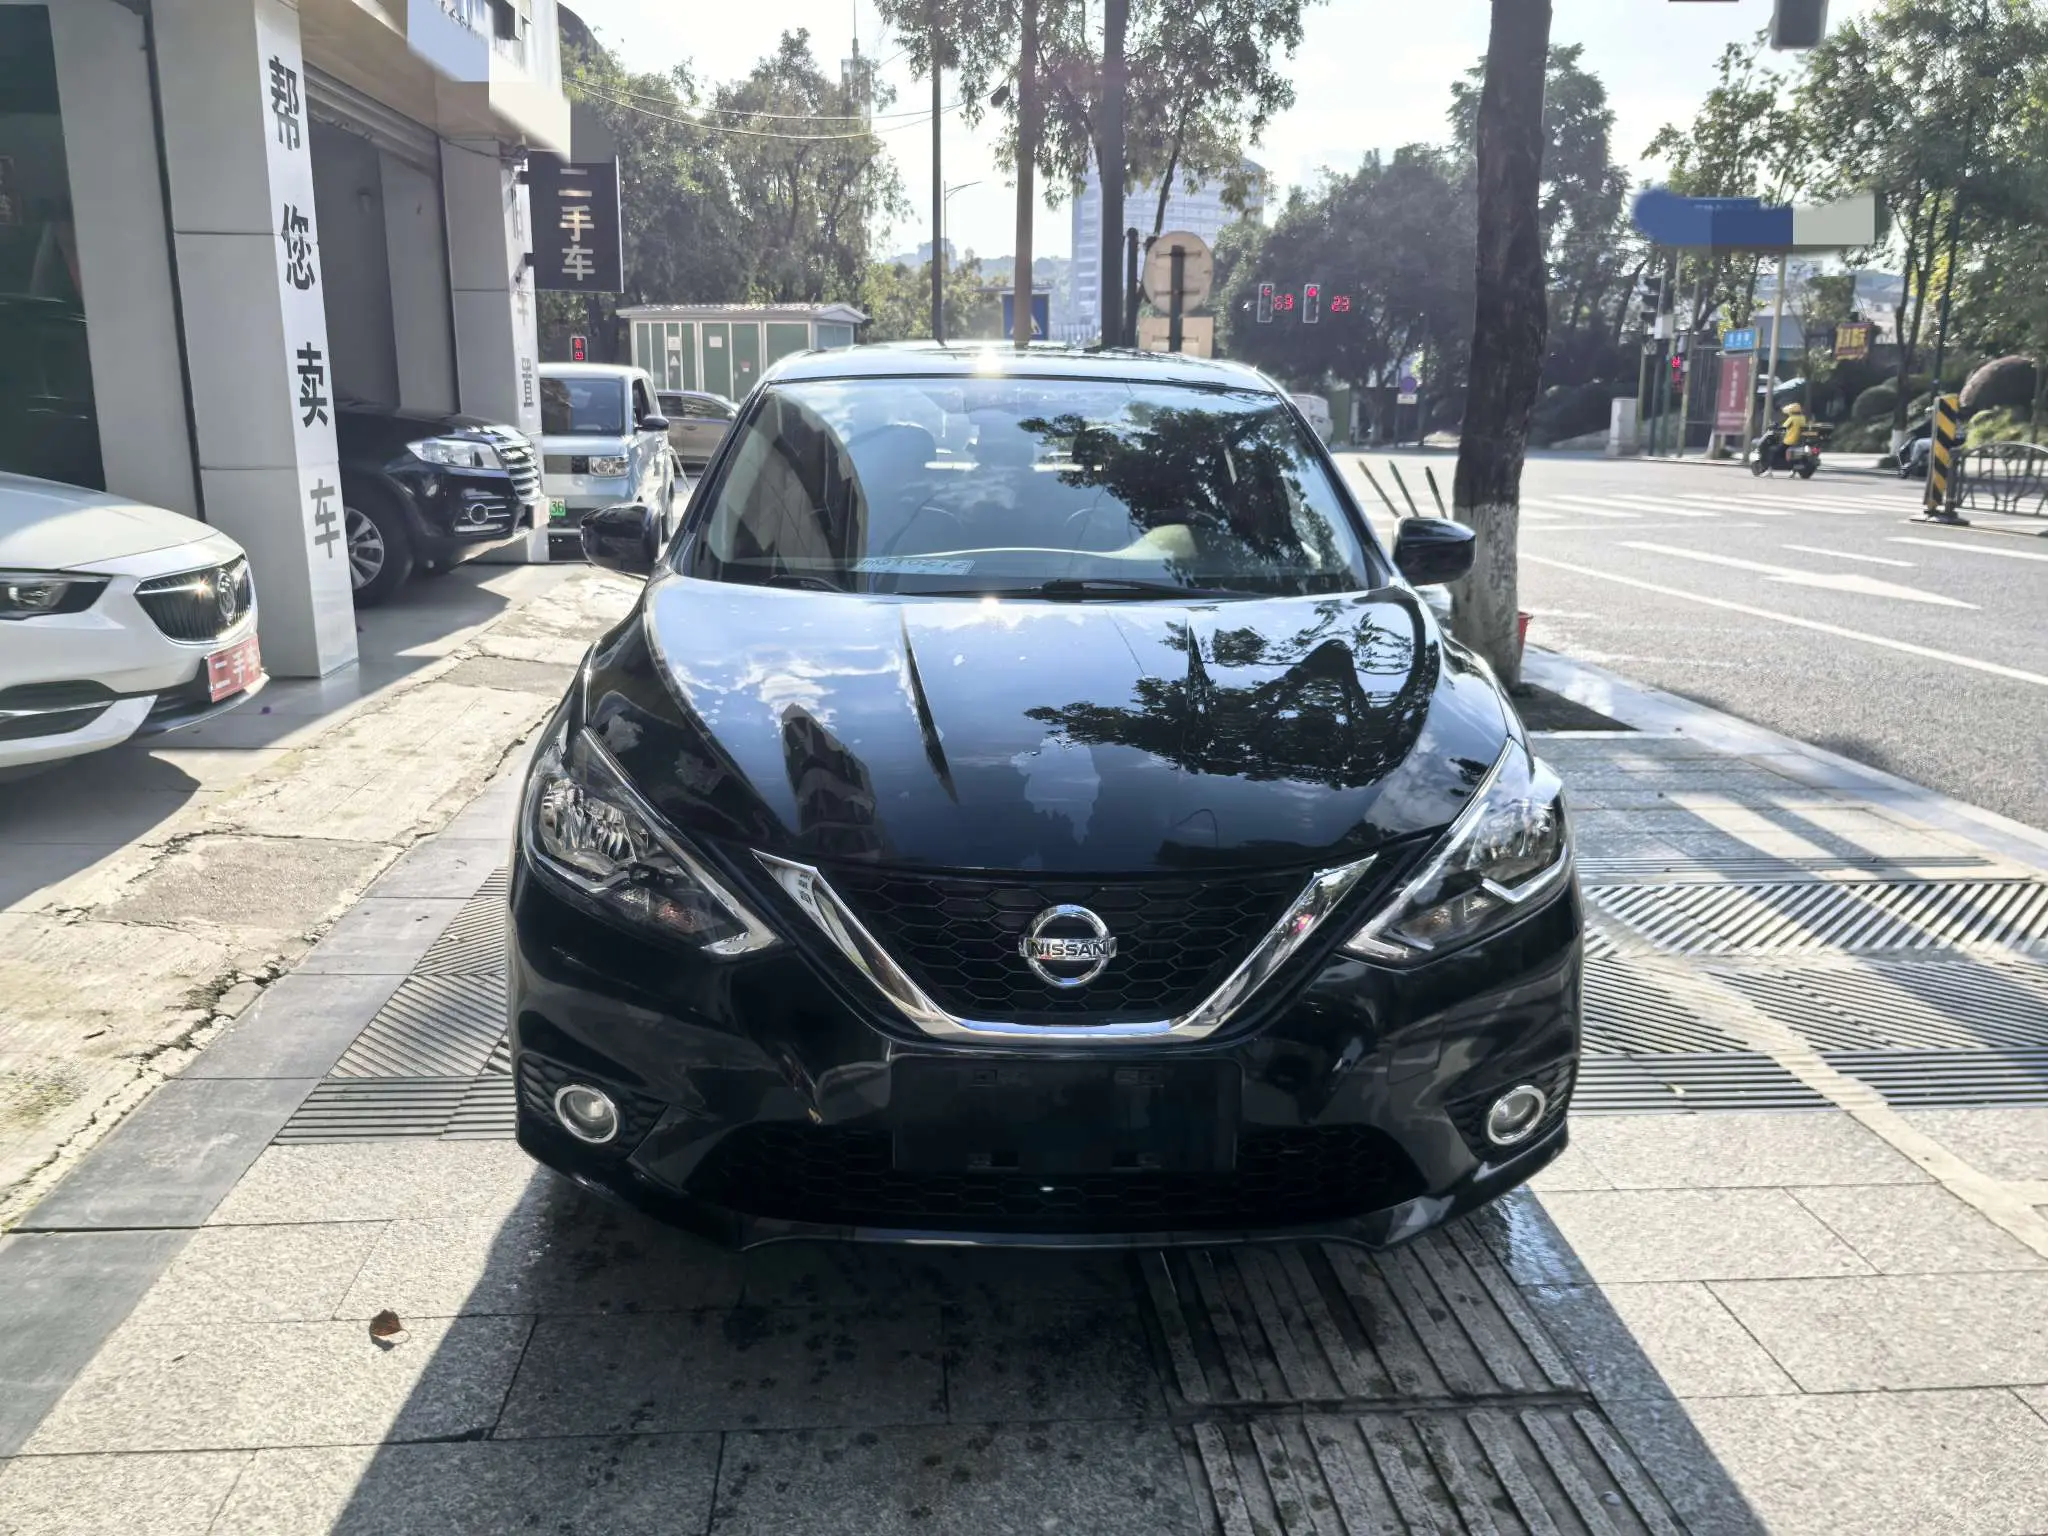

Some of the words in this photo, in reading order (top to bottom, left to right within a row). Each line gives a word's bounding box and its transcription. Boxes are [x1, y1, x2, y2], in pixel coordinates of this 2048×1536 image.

[558, 168, 596, 281] 二手车
[268, 55, 341, 559] 帮您卖车
[1029, 940, 1107, 957] NISSAN
